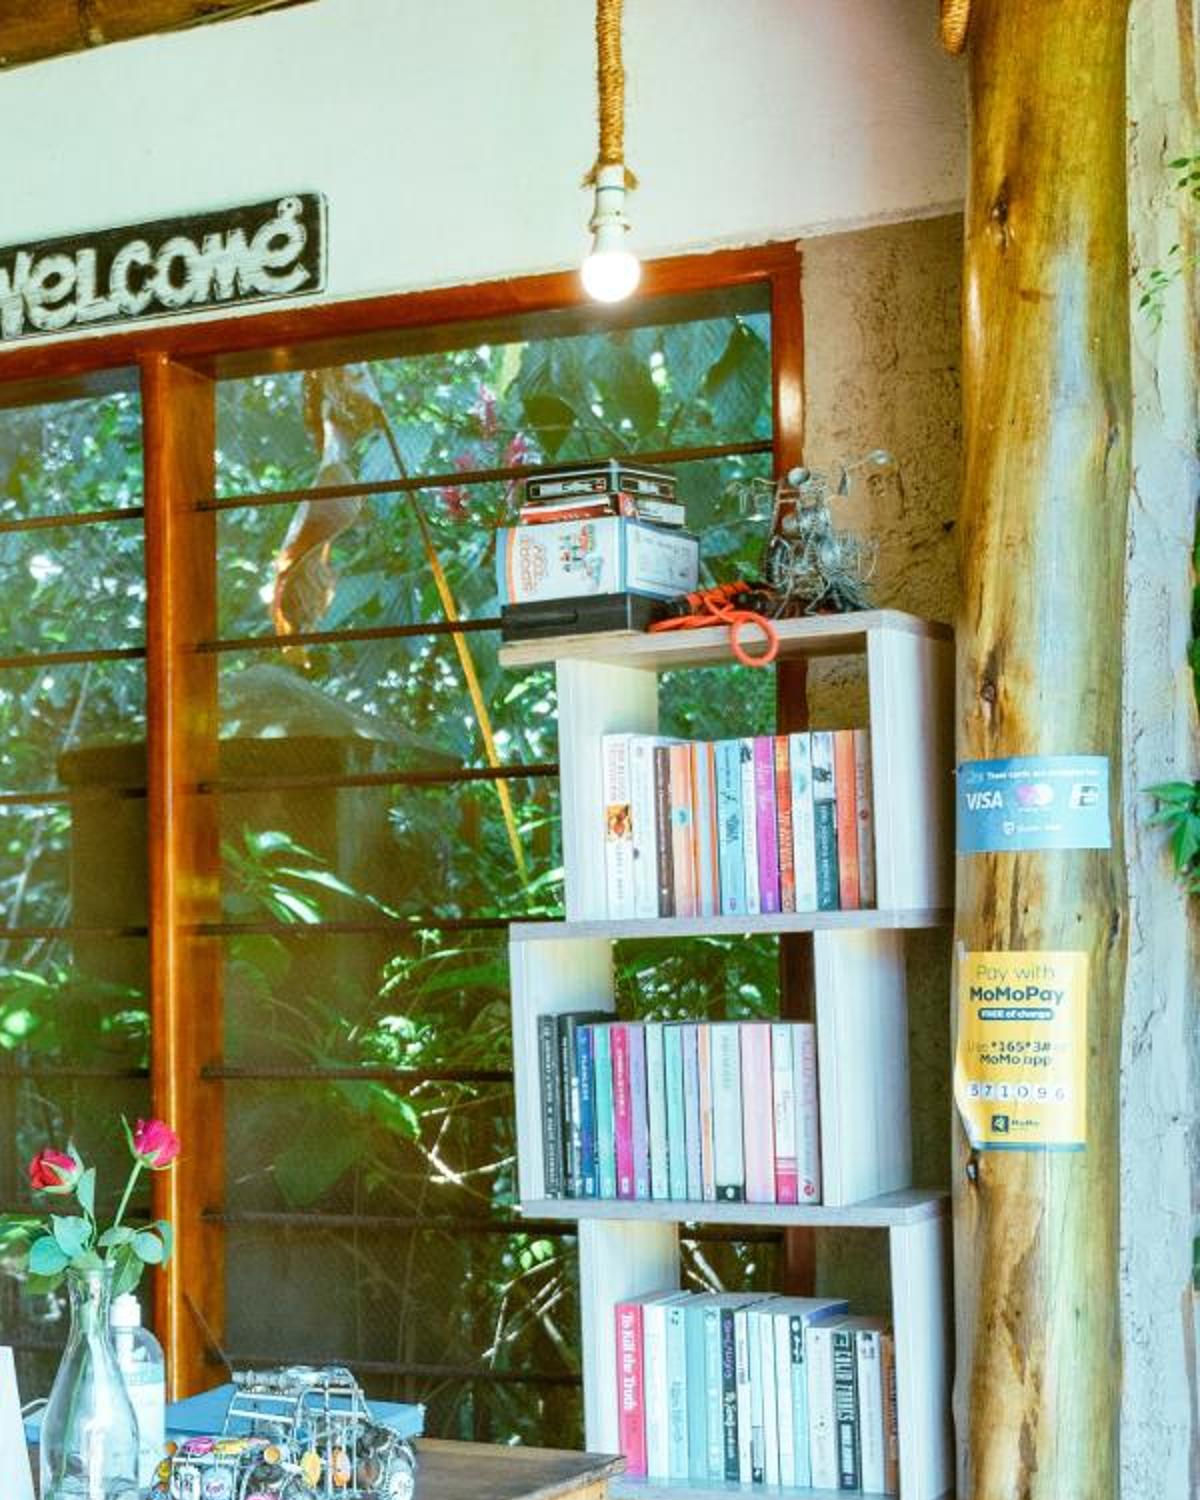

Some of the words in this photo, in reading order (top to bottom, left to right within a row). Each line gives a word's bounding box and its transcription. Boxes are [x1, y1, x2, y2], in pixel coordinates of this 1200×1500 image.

[966, 790, 1003, 810] VISA
[976, 965, 1006, 981] Pay
[1015, 964, 1056, 979] with
[969, 986, 1064, 1005] MoMoPay
[979, 1054, 1021, 1065] MoMo
[1023, 1055, 1052, 1067] app
[623, 1329, 636, 1351] Kill
[623, 1354, 636, 1373] the
[624, 1375, 637, 1410] Truth
